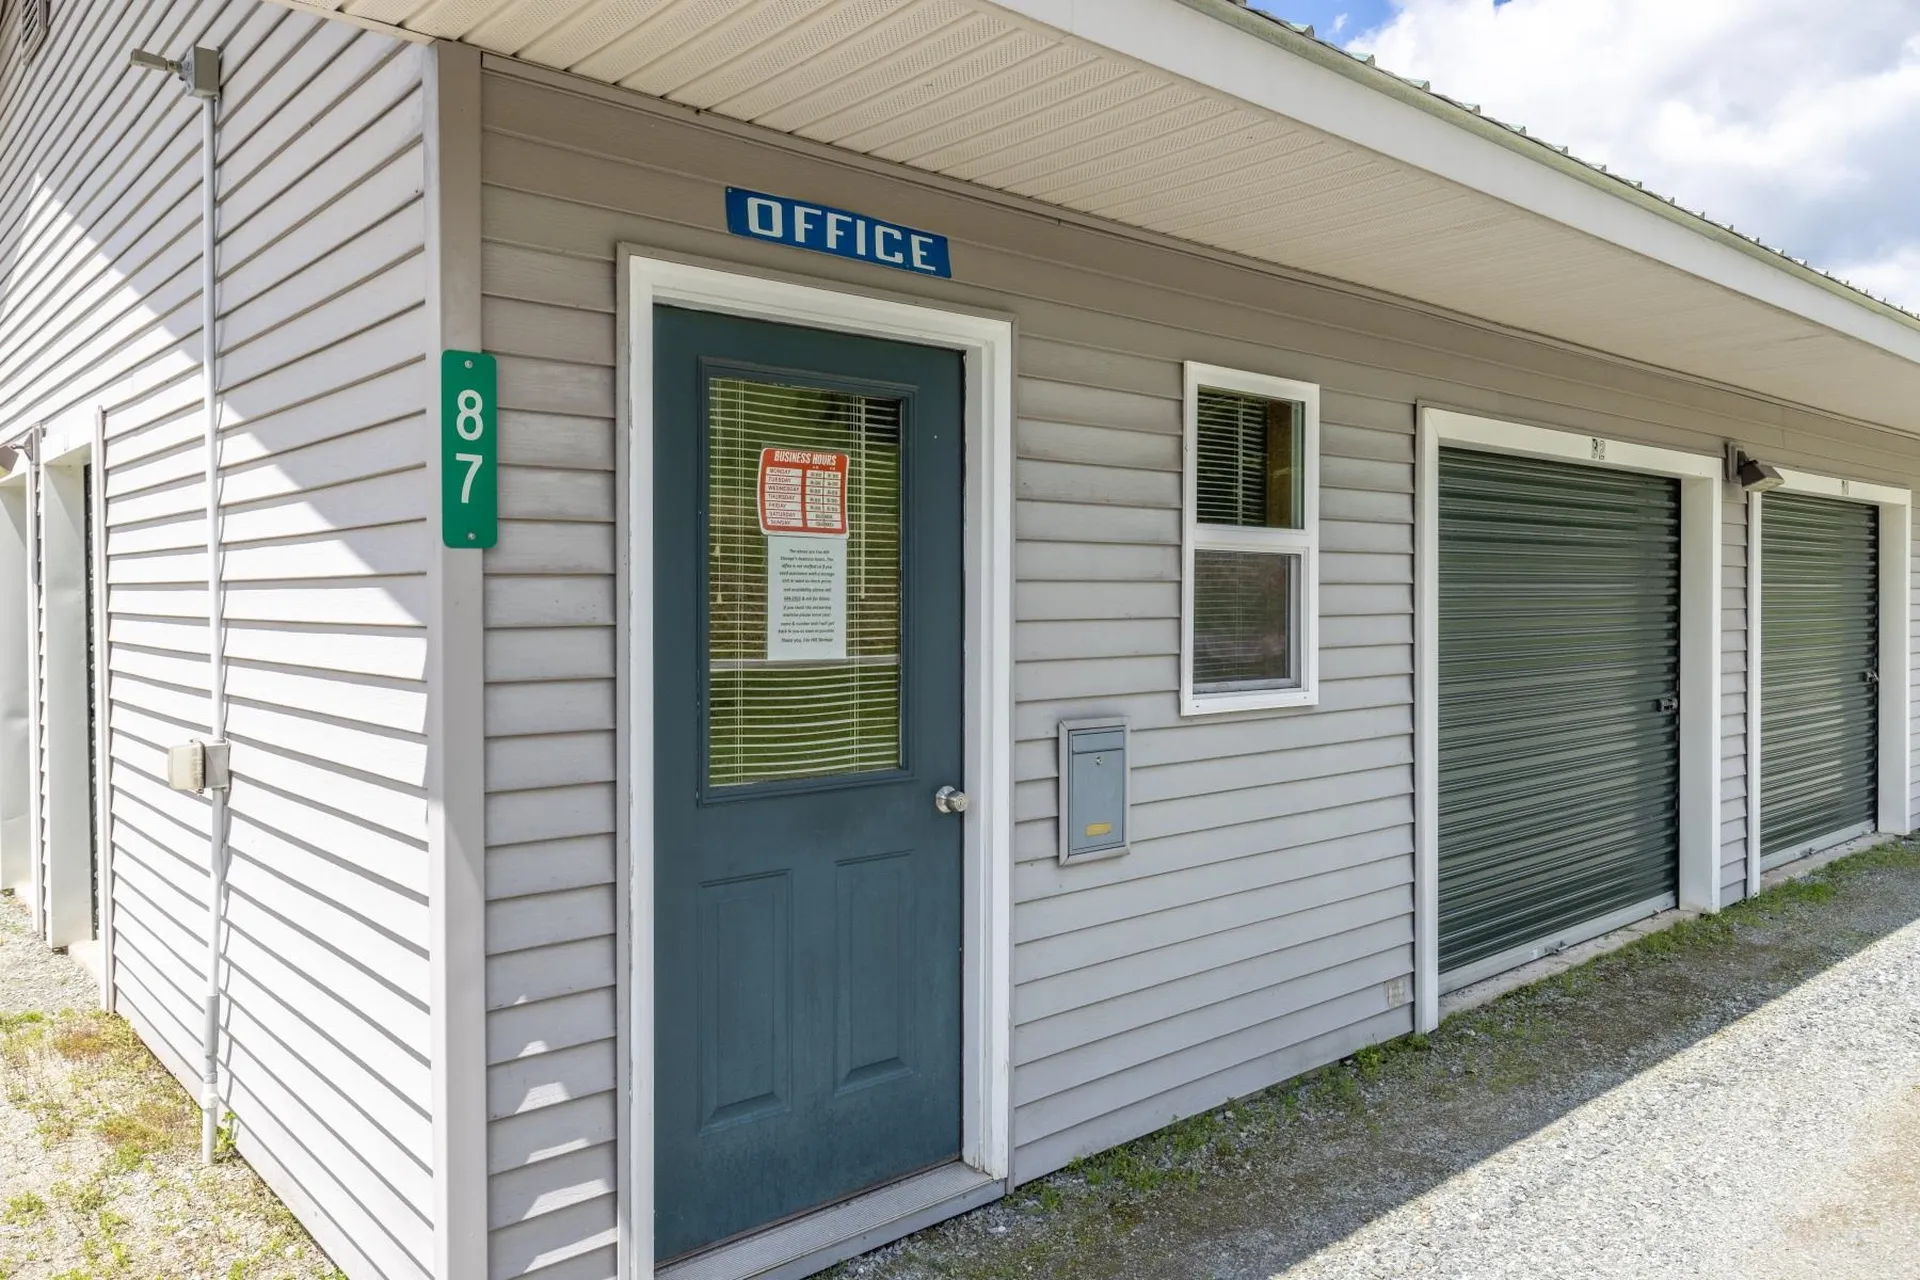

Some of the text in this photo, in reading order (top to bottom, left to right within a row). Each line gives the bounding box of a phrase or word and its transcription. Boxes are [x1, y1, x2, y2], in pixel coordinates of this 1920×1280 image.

[747, 197, 936, 271] OFFICE
[456, 389, 484, 504] 87
[774, 451, 837, 466] BUSINESS HOURS
